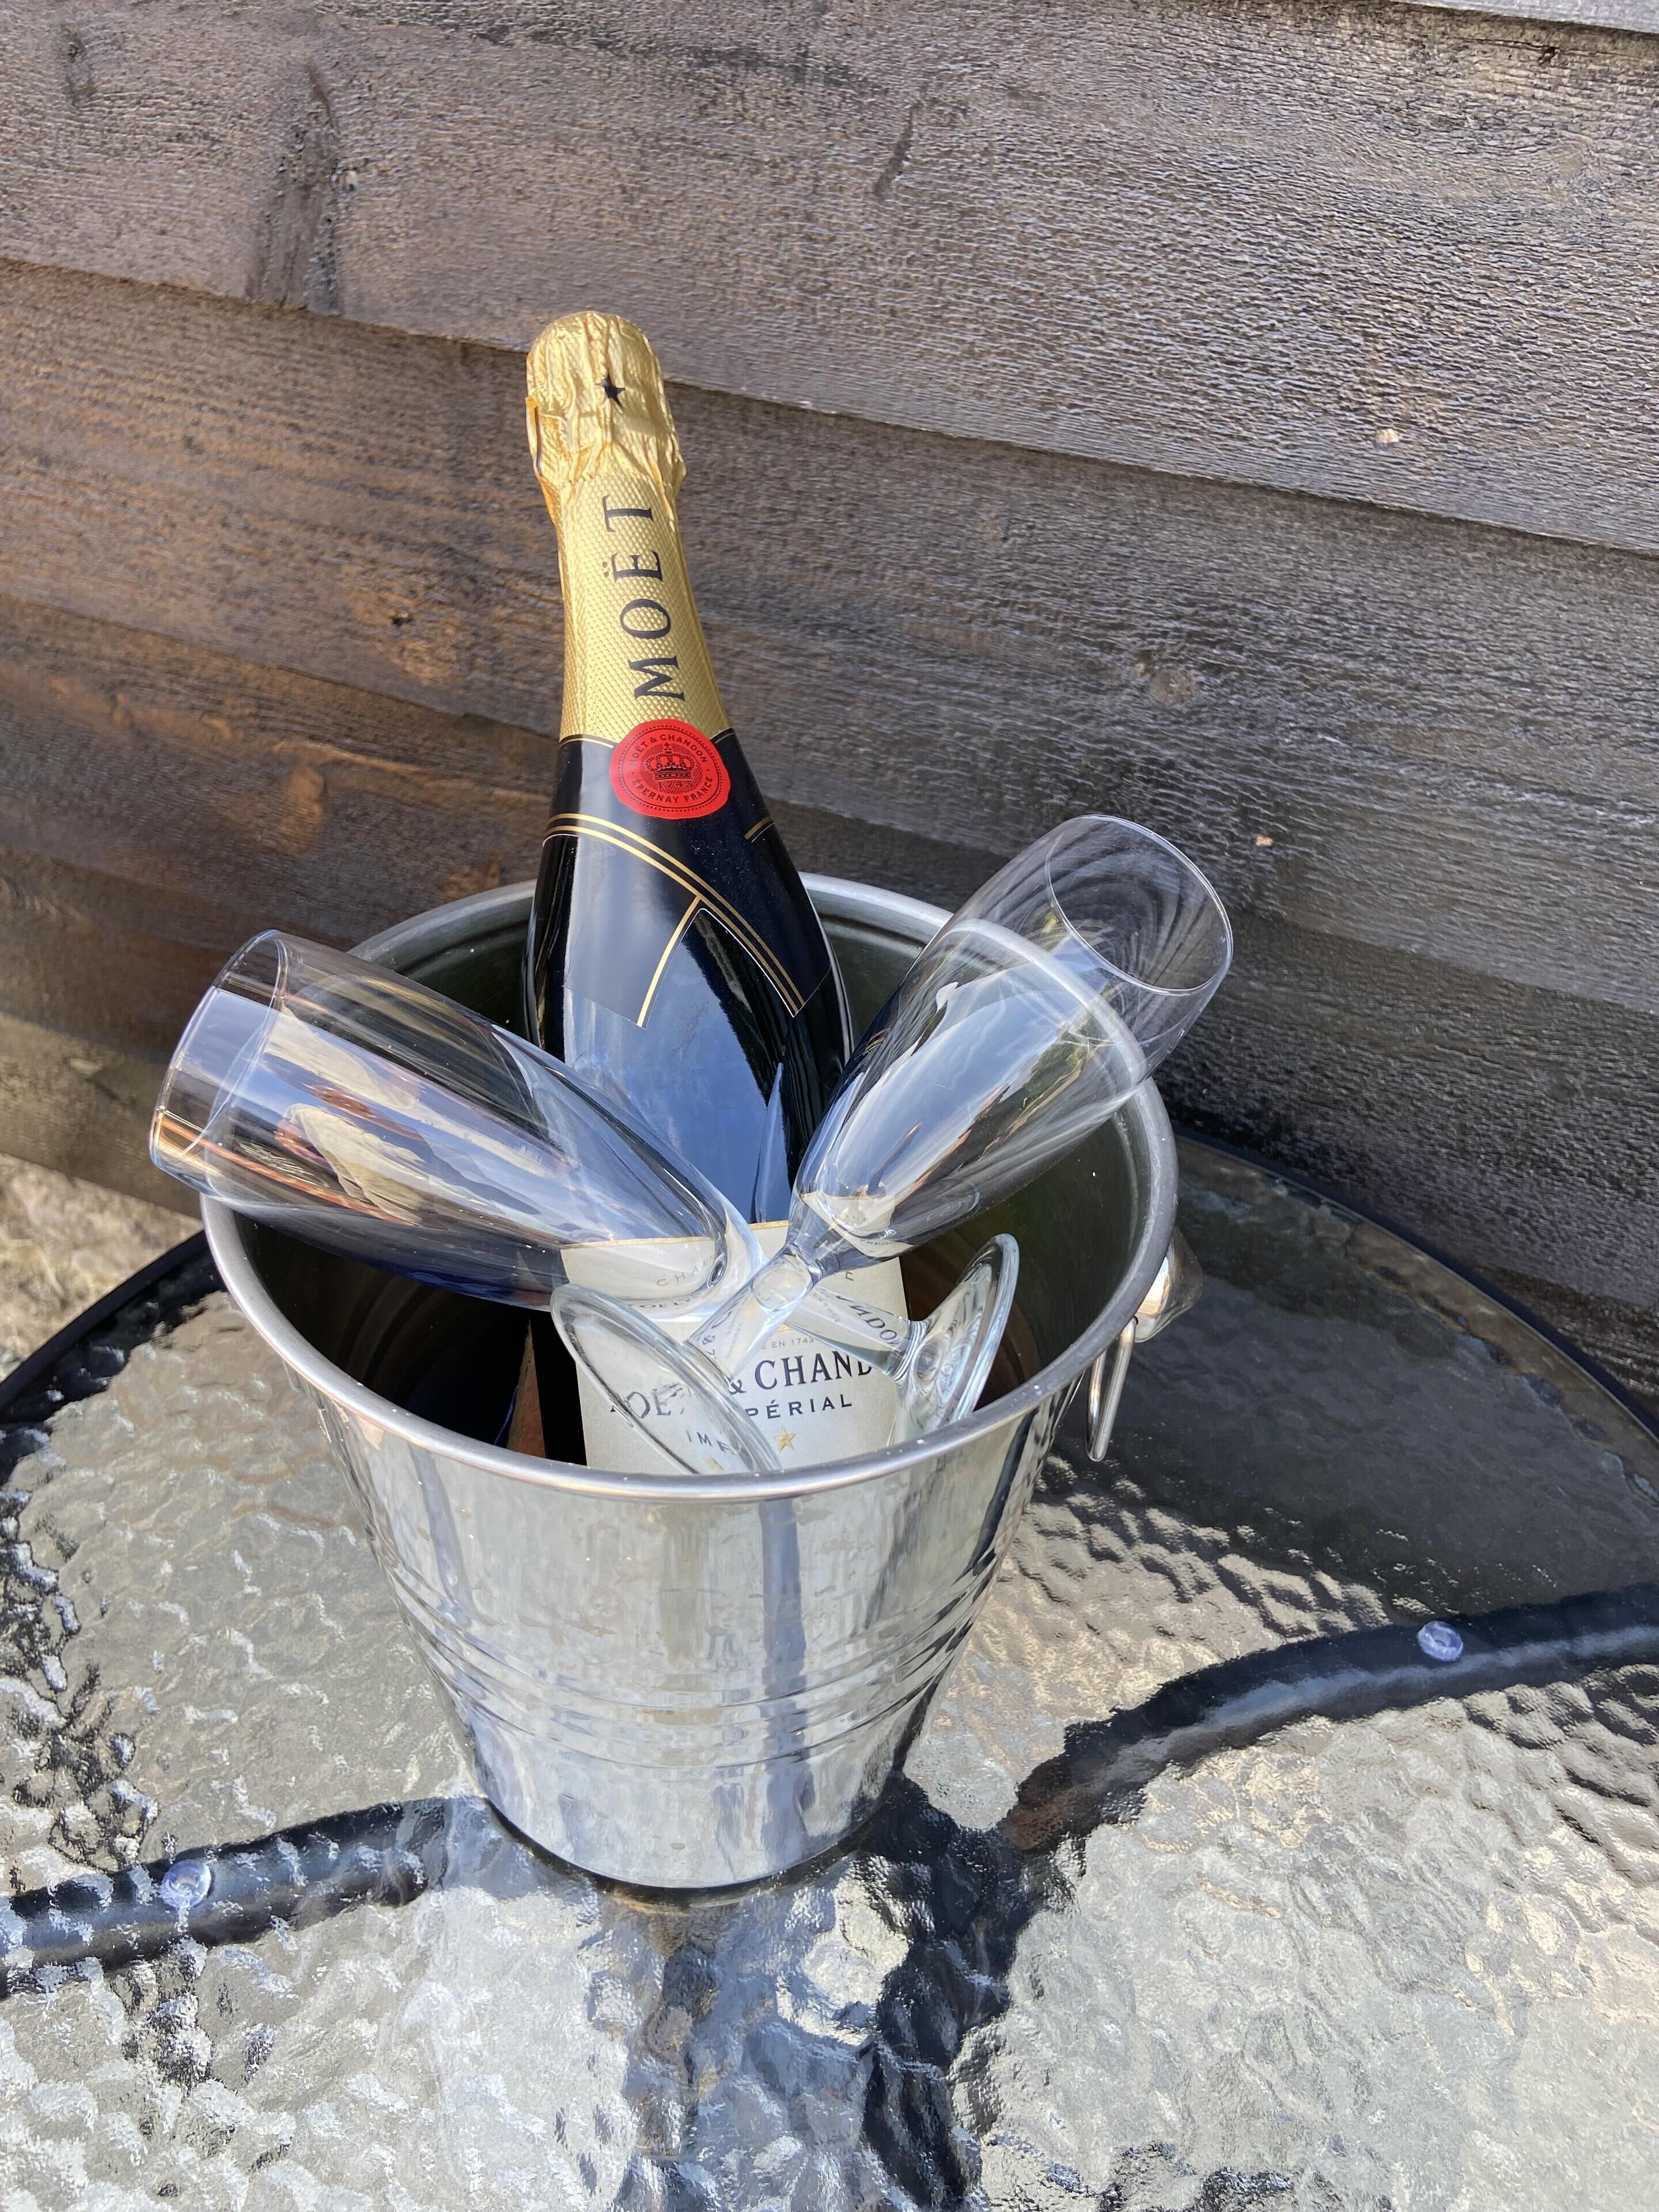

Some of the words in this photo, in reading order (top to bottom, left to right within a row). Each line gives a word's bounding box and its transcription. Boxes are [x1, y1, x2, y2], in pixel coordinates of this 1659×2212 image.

[603, 494, 685, 702] MOËT
[628, 741, 650, 766] MOËT
[660, 734, 709, 763] CHANDON
[684, 776, 714, 802] FRANCE
[754, 1350, 872, 1390] CHAND
